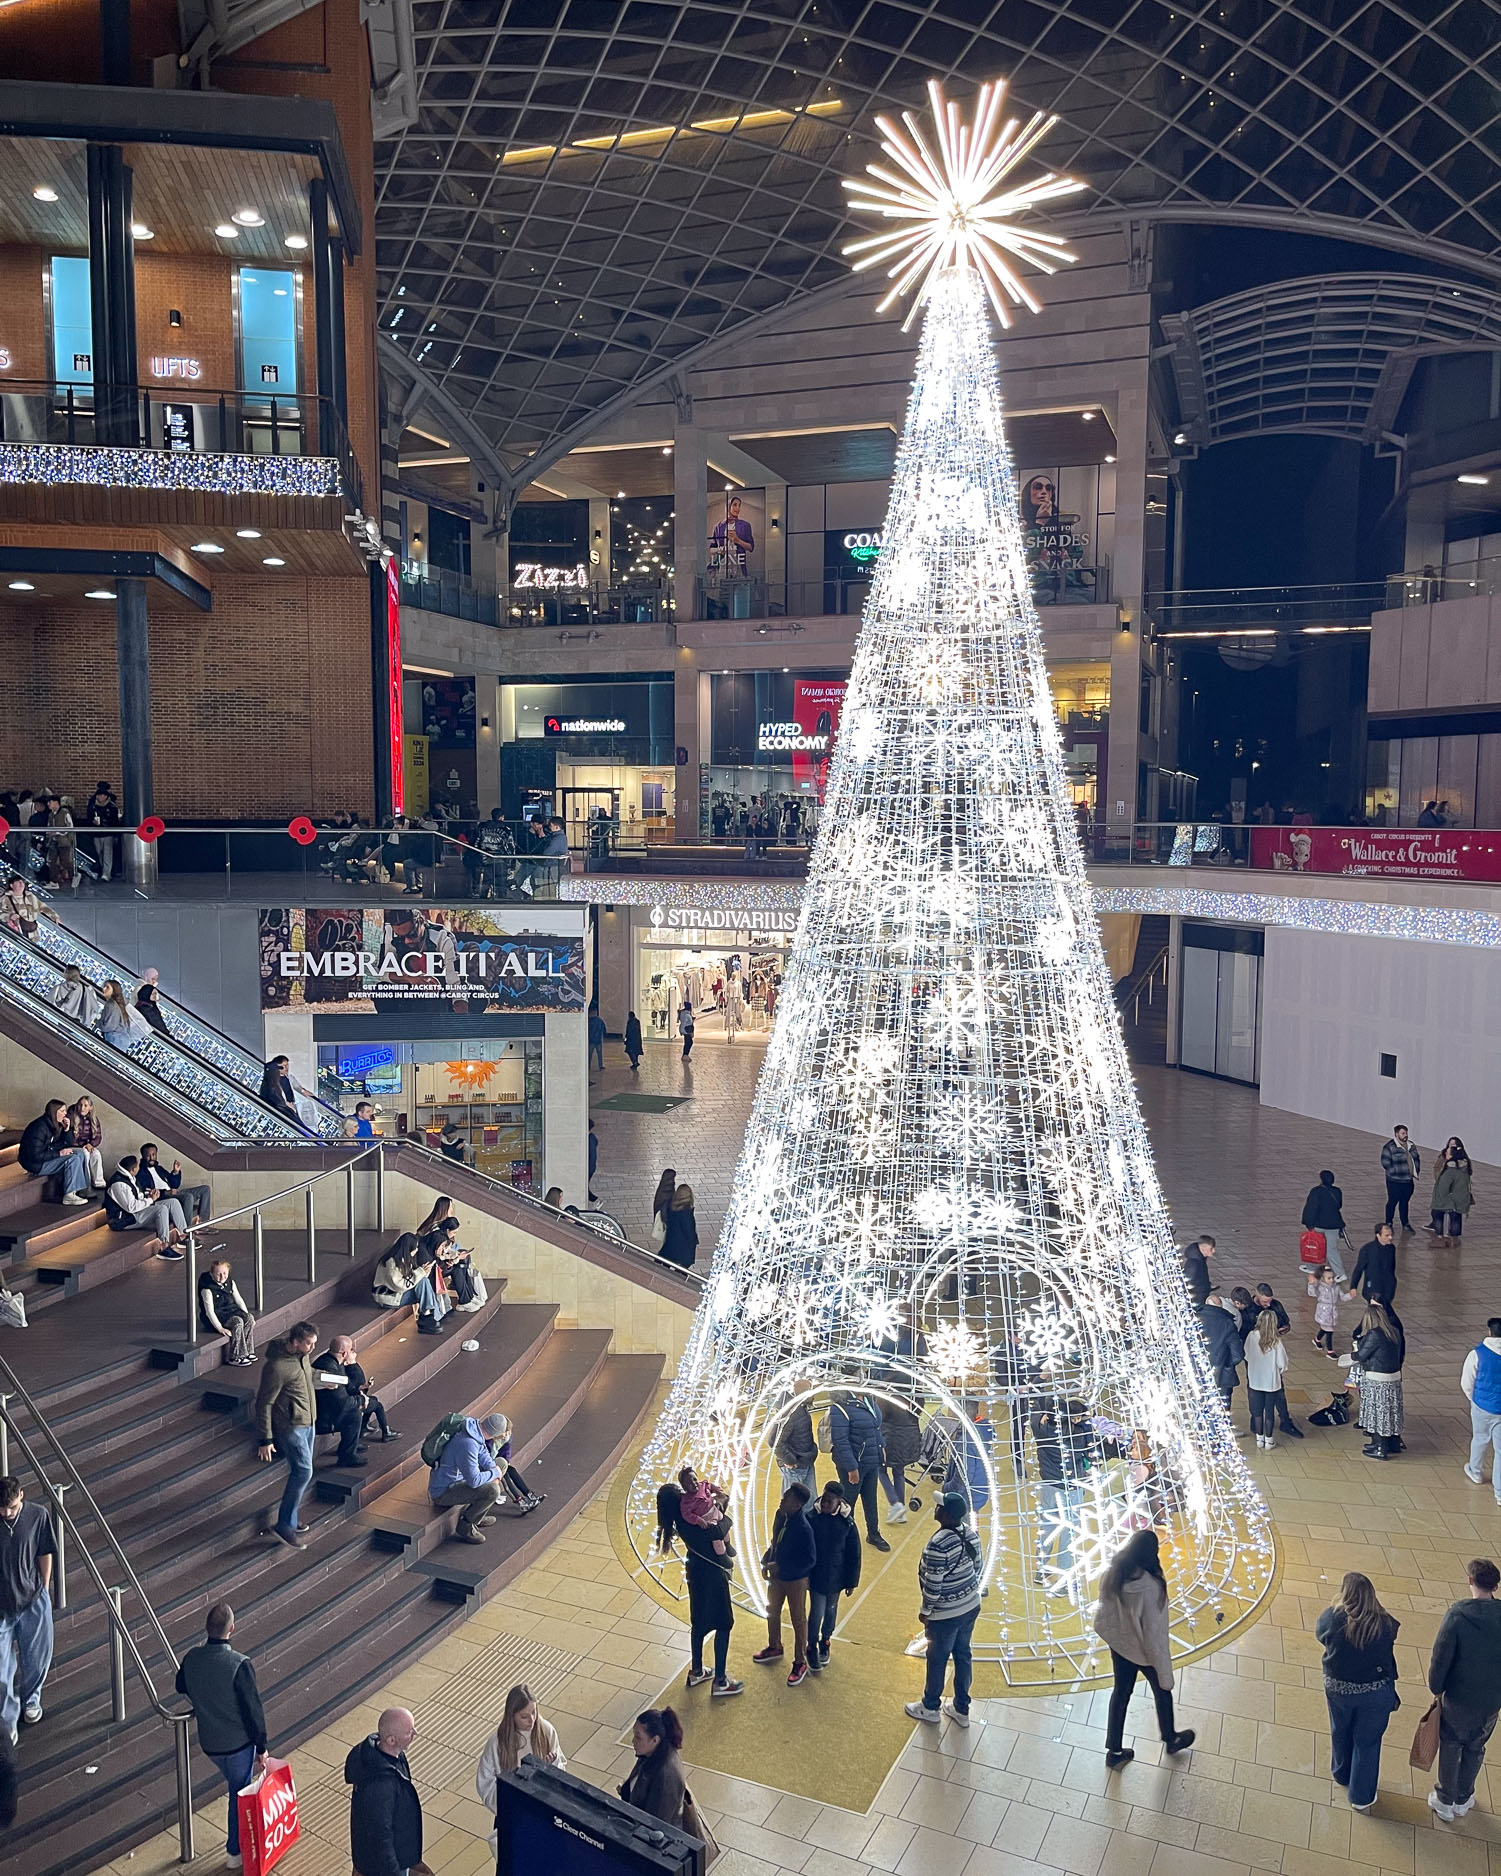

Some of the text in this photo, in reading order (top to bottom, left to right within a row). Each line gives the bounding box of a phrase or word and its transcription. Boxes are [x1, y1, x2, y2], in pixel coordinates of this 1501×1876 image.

[152, 356, 201, 379] LIFTS
[843, 532, 889, 549] COA
[1026, 533, 1090, 549] SHADES
[711, 553, 746, 566] LUXE
[1030, 558, 1084, 572] SNACK
[561, 719, 626, 732] nationwide
[759, 722, 802, 737] HYPED
[758, 735, 829, 750] ECONOMY
[1350, 838, 1458, 864] Wallace & Gromit
[1383, 865, 1418, 875] CHRISTMAS
[1419, 866, 1458, 877] EXPERIENCE
[667, 908, 796, 931] STRADIVARIUS
[280, 951, 565, 978] EMBRACE IT ALL
[409, 984, 445, 992] JACKETS,
[579, 1831, 605, 1850] Channel
